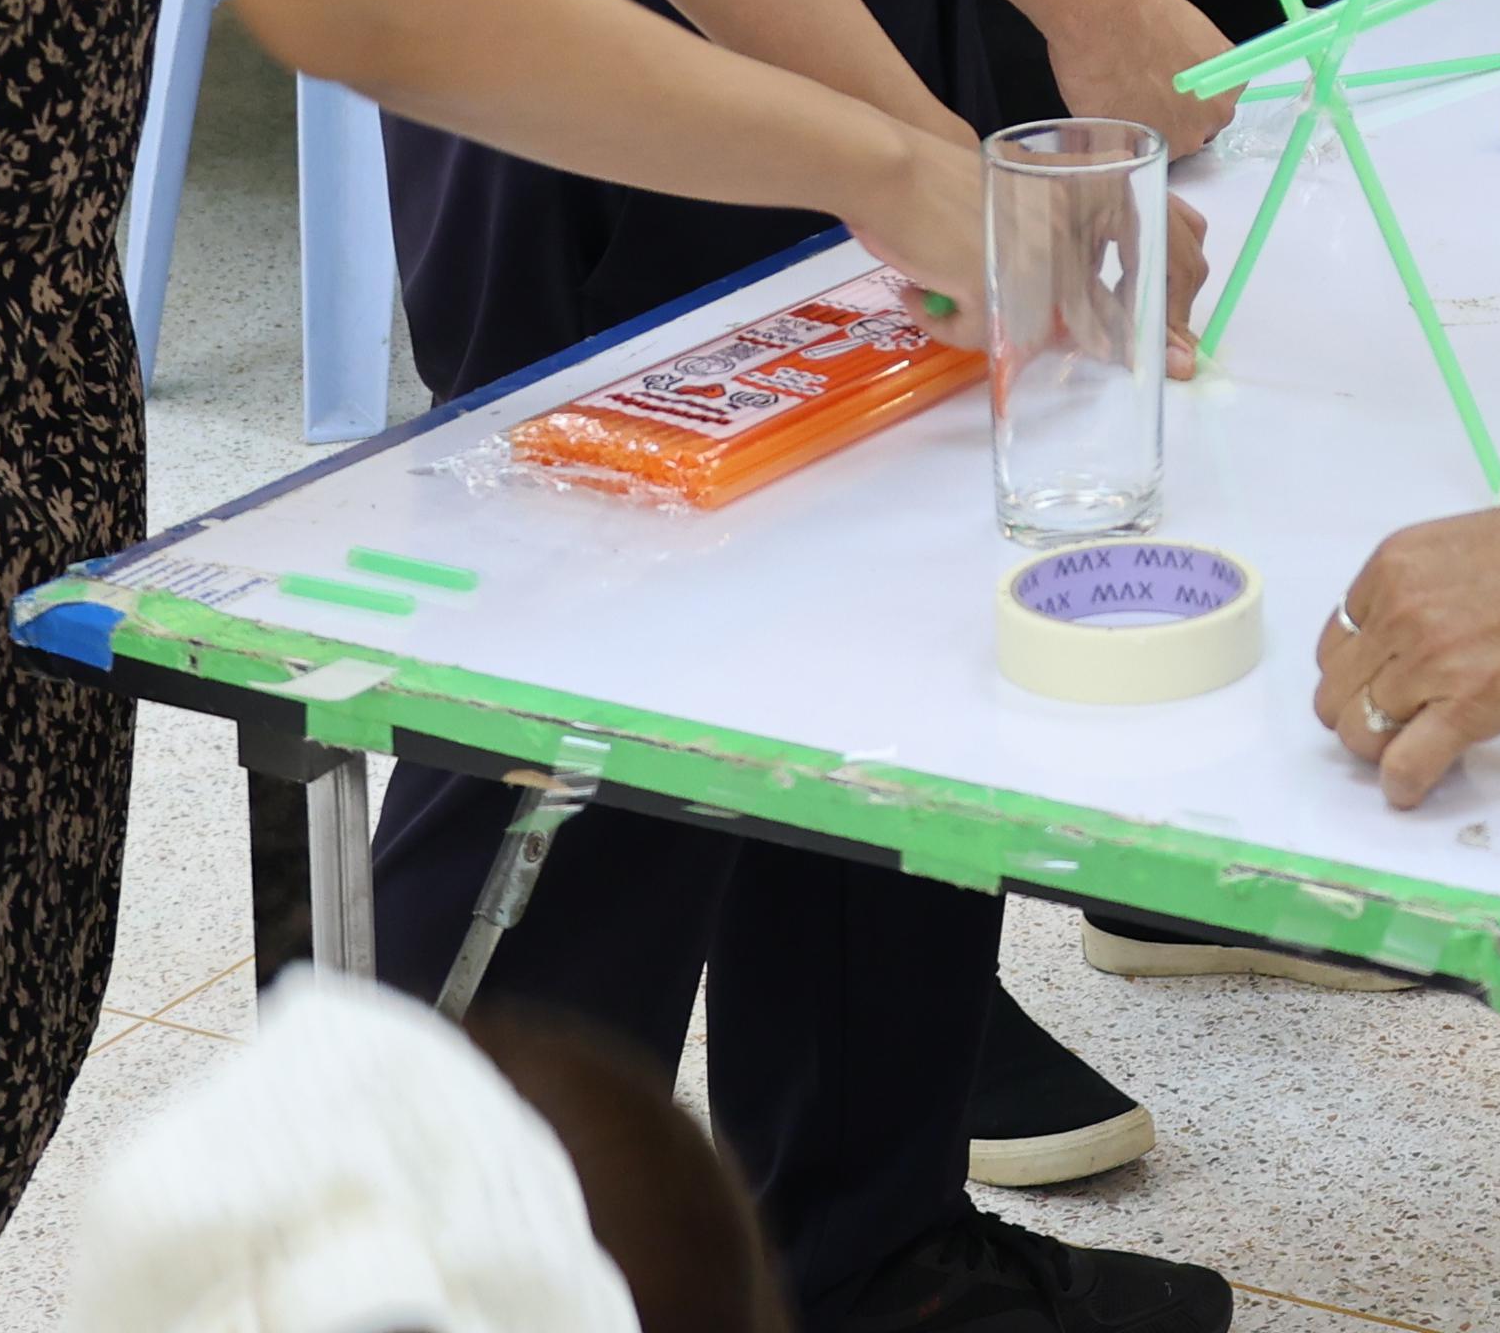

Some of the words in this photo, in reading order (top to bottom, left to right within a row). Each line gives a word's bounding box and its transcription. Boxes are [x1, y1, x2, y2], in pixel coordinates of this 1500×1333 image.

[1054, 549, 1112, 579] MAX
[1133, 547, 1194, 572] MAX
[1091, 581, 1155, 606] MAX
